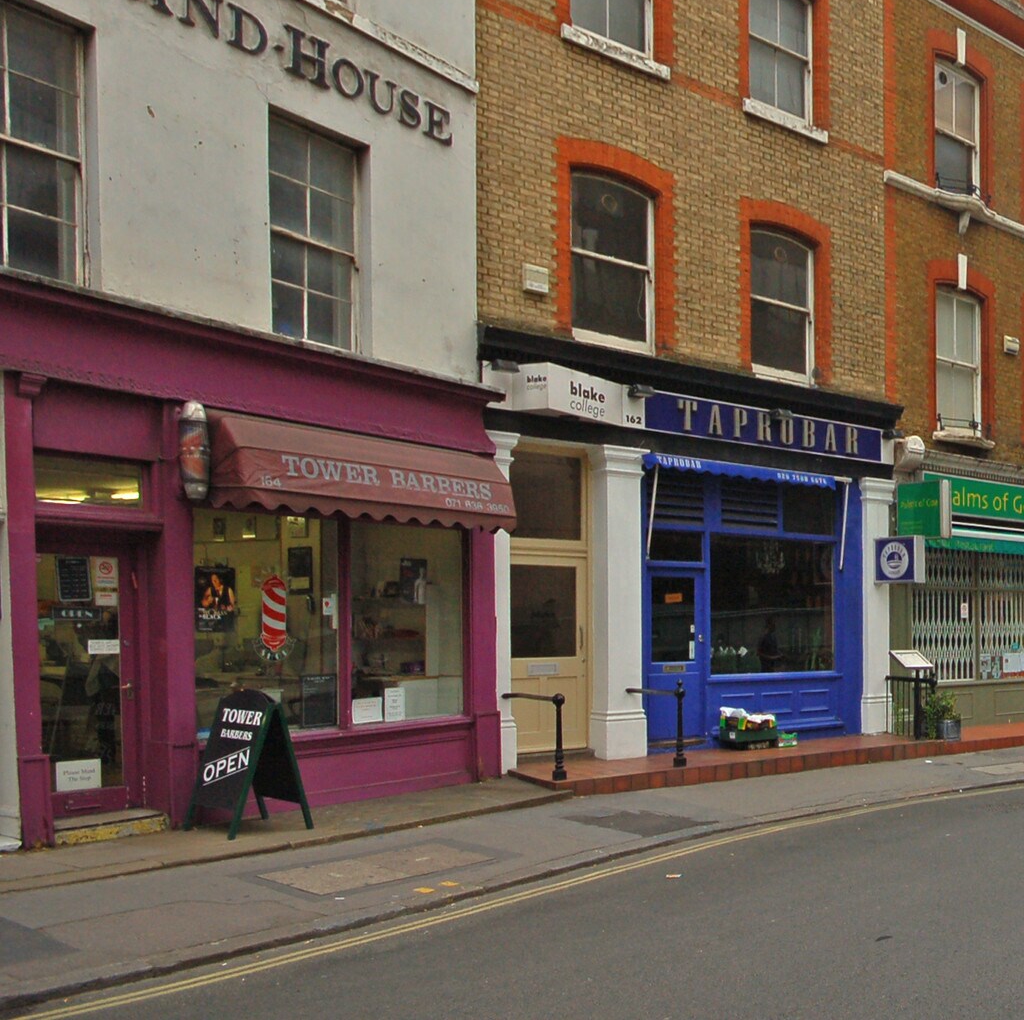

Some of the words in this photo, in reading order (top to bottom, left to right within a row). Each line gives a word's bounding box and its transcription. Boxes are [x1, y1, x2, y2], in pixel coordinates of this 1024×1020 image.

[284, 23, 454, 146] HOUSE
[526, 375, 547, 383] blake
[569, 381, 605, 403] blake
[569, 399, 605, 418] college
[625, 414, 642, 425] 162
[677, 398, 859, 456] TAPROBAR
[281, 454, 380, 487] TOWER
[388, 468, 492, 501] BARBERS
[445, 497, 462, 507] 071
[953, 486, 989, 510] alms
[992, 492, 1009, 513] of
[222, 707, 263, 726] TOWER
[220, 728, 253, 741] BARBERS
[203, 749, 250, 782] OPEN
